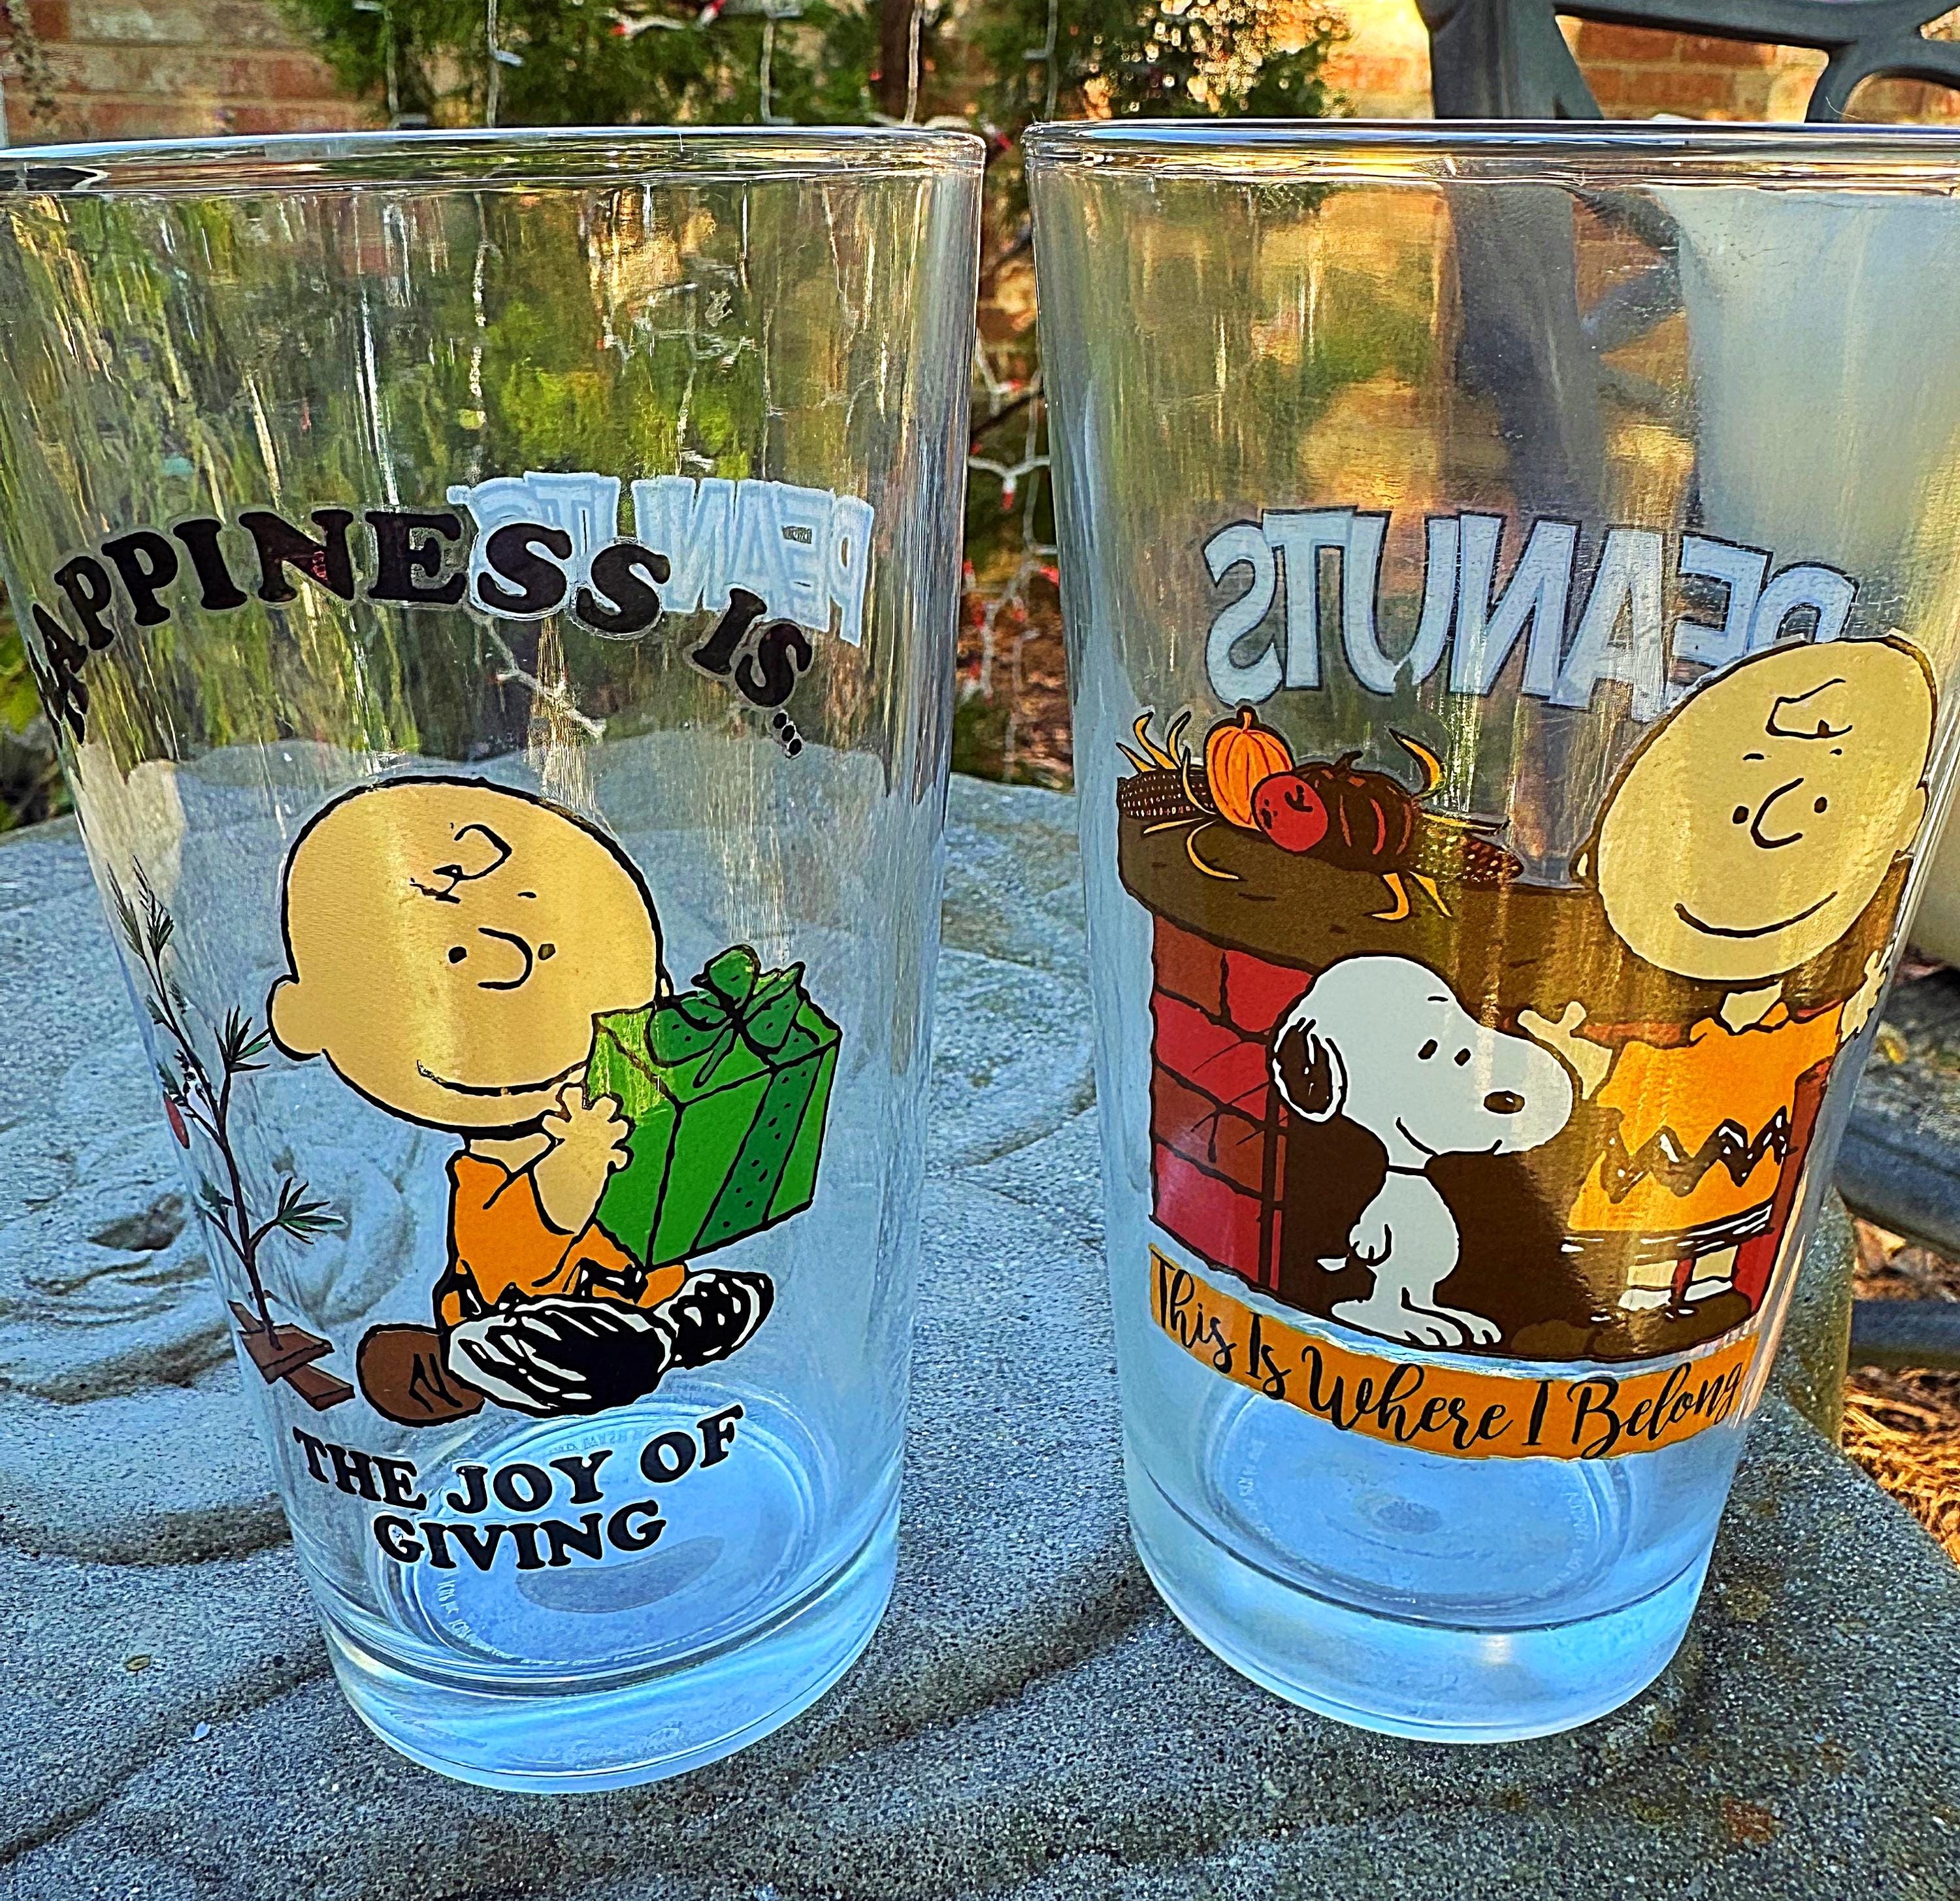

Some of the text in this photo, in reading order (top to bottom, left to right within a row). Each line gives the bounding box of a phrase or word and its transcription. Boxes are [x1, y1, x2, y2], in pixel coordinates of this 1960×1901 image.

[1150, 1250, 1744, 1460] This Is Where I Belong
[292, 1402, 744, 1514] THE JOY OF
[374, 1500, 667, 1571] GIVING
